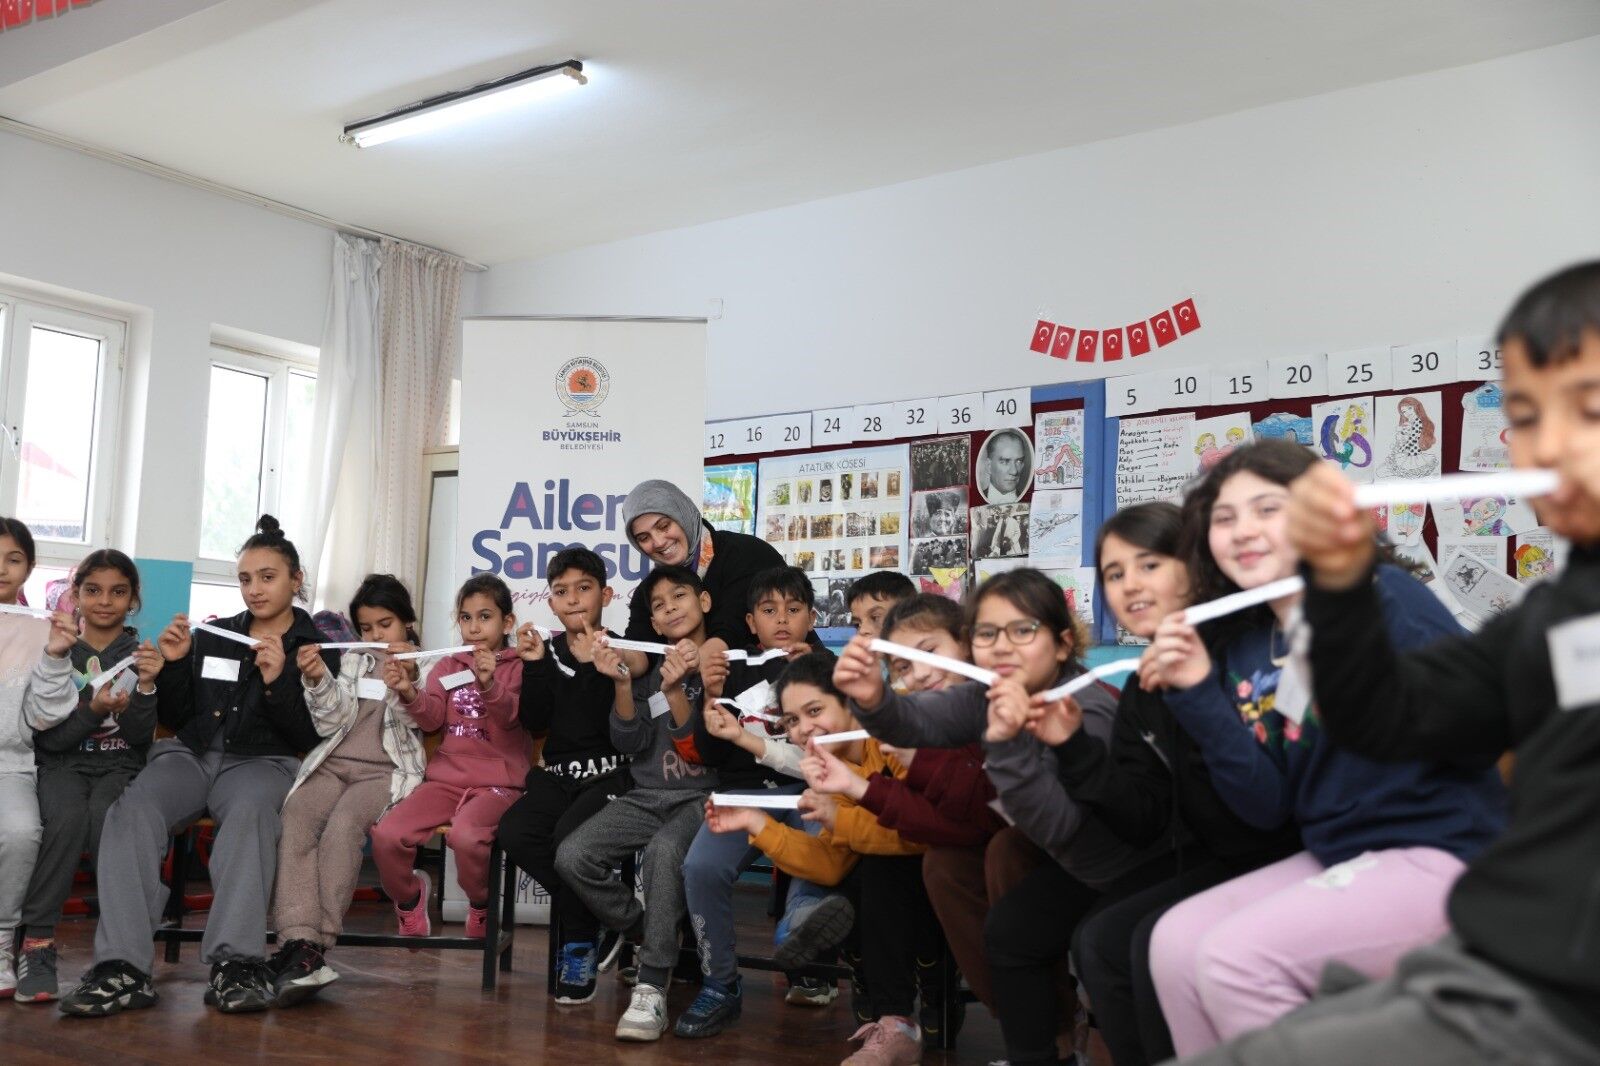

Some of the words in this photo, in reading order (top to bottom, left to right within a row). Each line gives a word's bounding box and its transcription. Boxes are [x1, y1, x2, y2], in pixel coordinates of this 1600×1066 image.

[1126, 388, 1137, 406] 5
[1173, 376, 1197, 395] 10
[1228, 375, 1253, 395] 15
[1286, 364, 1312, 385] 20
[1346, 363, 1374, 384] 25
[1411, 351, 1439, 373] 30
[542, 428, 622, 443] BÜYÜKŞEHİR
[709, 433, 725, 449] 12
[746, 426, 763, 443] 16
[783, 426, 801, 442] 20
[823, 417, 841, 433] 24
[862, 416, 882, 433] 28
[906, 407, 925, 425] 32
[951, 406, 971, 425] 36
[995, 398, 1017, 416] 40
[560, 442, 604, 451] BELEDİYESİ
[799, 461, 835, 473] ATATÜRK
[471, 529, 652, 582] Sasu
